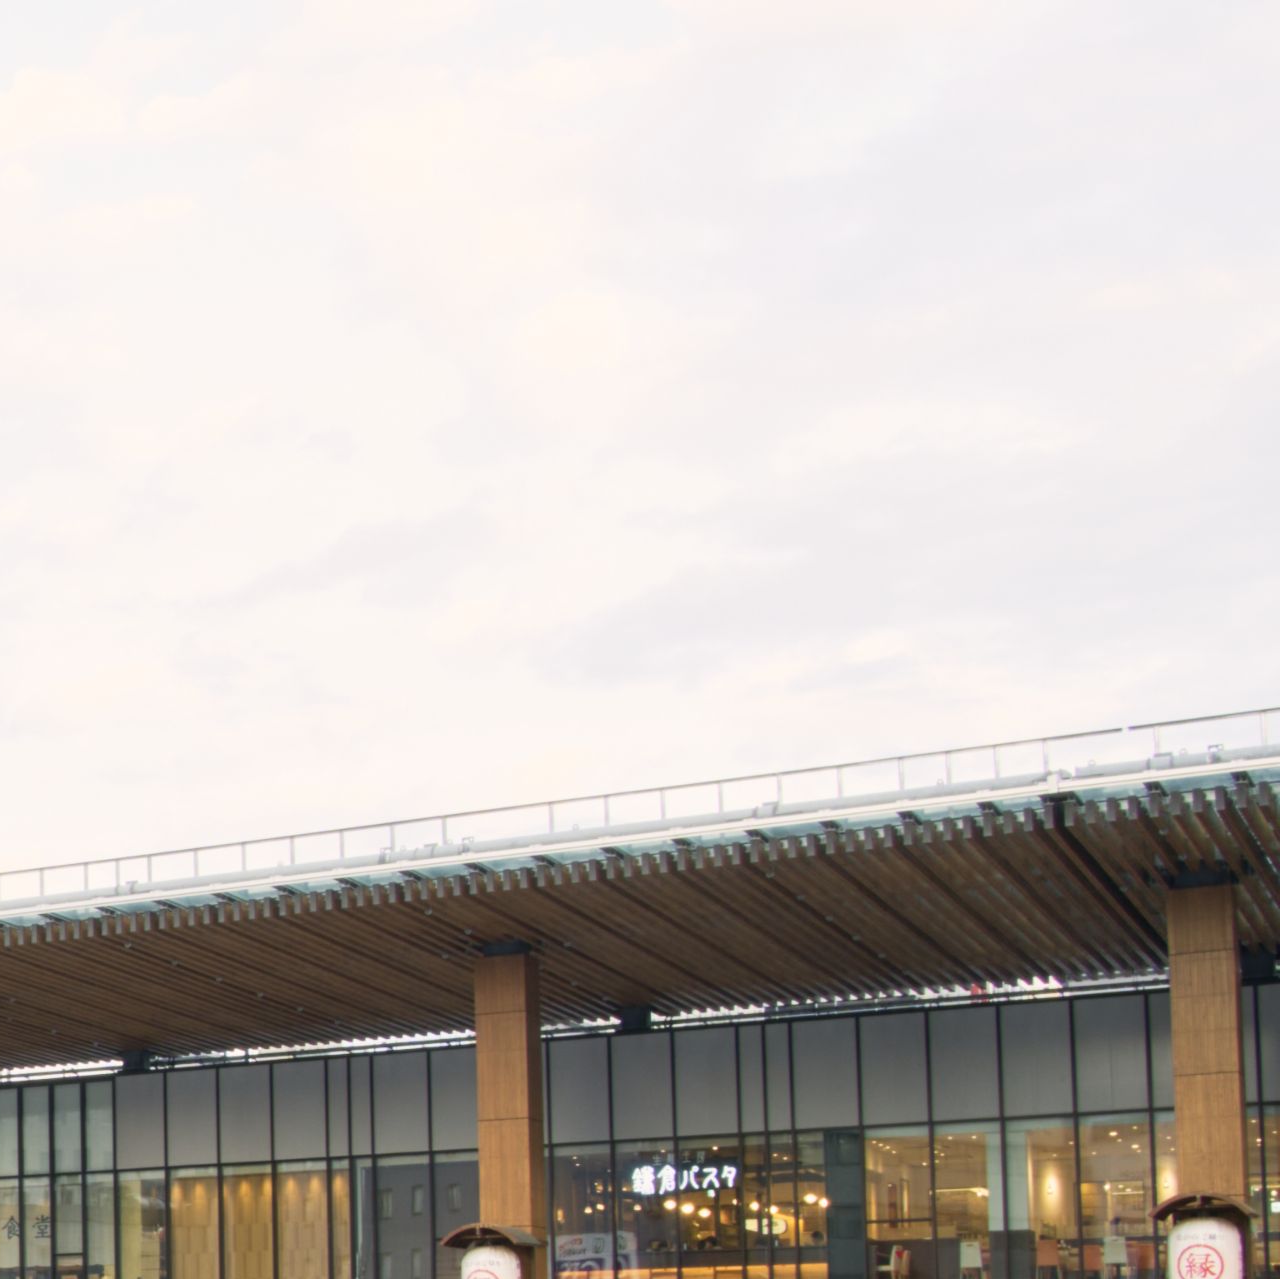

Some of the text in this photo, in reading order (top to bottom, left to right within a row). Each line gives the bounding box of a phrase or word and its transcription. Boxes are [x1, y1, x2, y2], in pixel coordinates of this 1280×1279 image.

[632, 1164, 737, 1195] 鎌倉パスタ
[1, 1213, 51, 1240] 食堂
